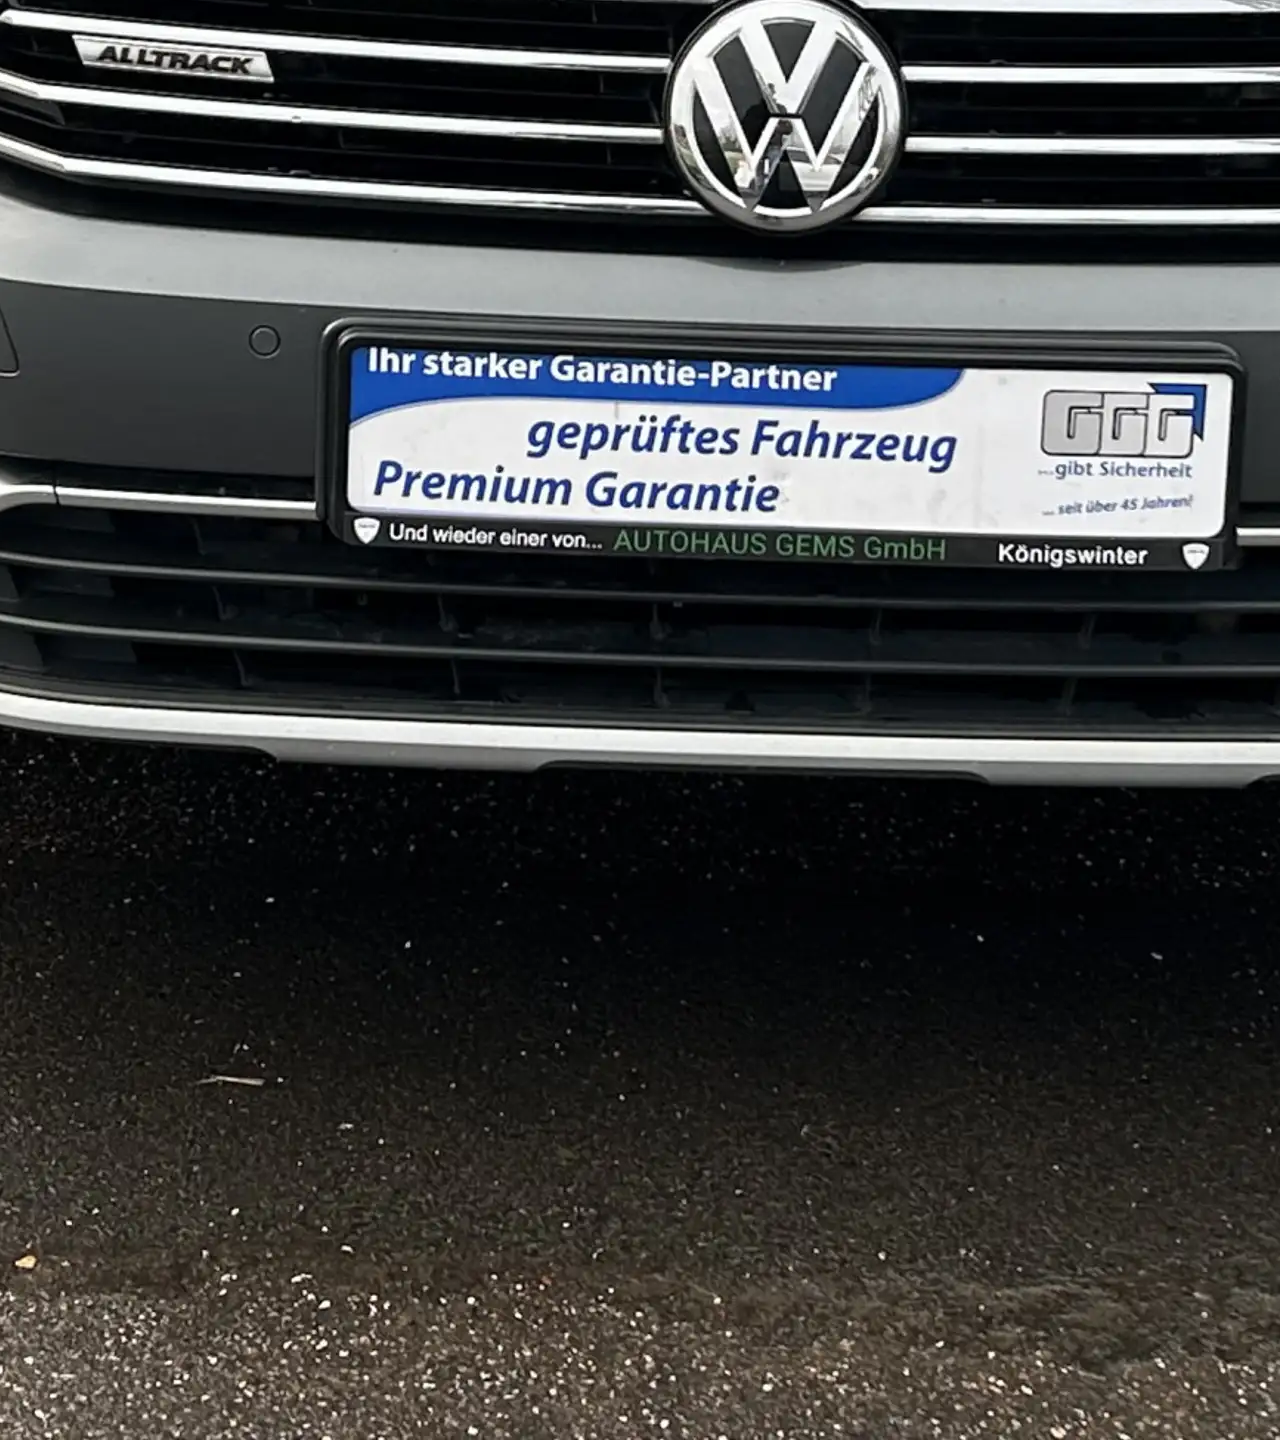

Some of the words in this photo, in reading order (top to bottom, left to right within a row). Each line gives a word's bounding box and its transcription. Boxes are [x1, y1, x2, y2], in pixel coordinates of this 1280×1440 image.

[96, 45, 254, 75] ALLTRACK
[368, 346, 416, 374] Ihr
[422, 349, 543, 380] starker
[550, 354, 838, 392] Garantie-Partner
[1040, 388, 1195, 459] GGG
[526, 414, 740, 460] geprüftes
[750, 419, 958, 474] Fahrzeug
[372, 459, 573, 506] Premium
[585, 470, 781, 513] Garantie
[1099, 461, 1194, 479] Sicherheit
[1120, 498, 1138, 511] 45
[389, 521, 428, 543] Und
[433, 524, 495, 546] wieder
[499, 527, 548, 548] einer
[612, 528, 768, 556] AUTOHAUS
[775, 532, 855, 557] GEMS
[863, 535, 947, 562] GmbH
[997, 541, 1149, 569] Königswinter
